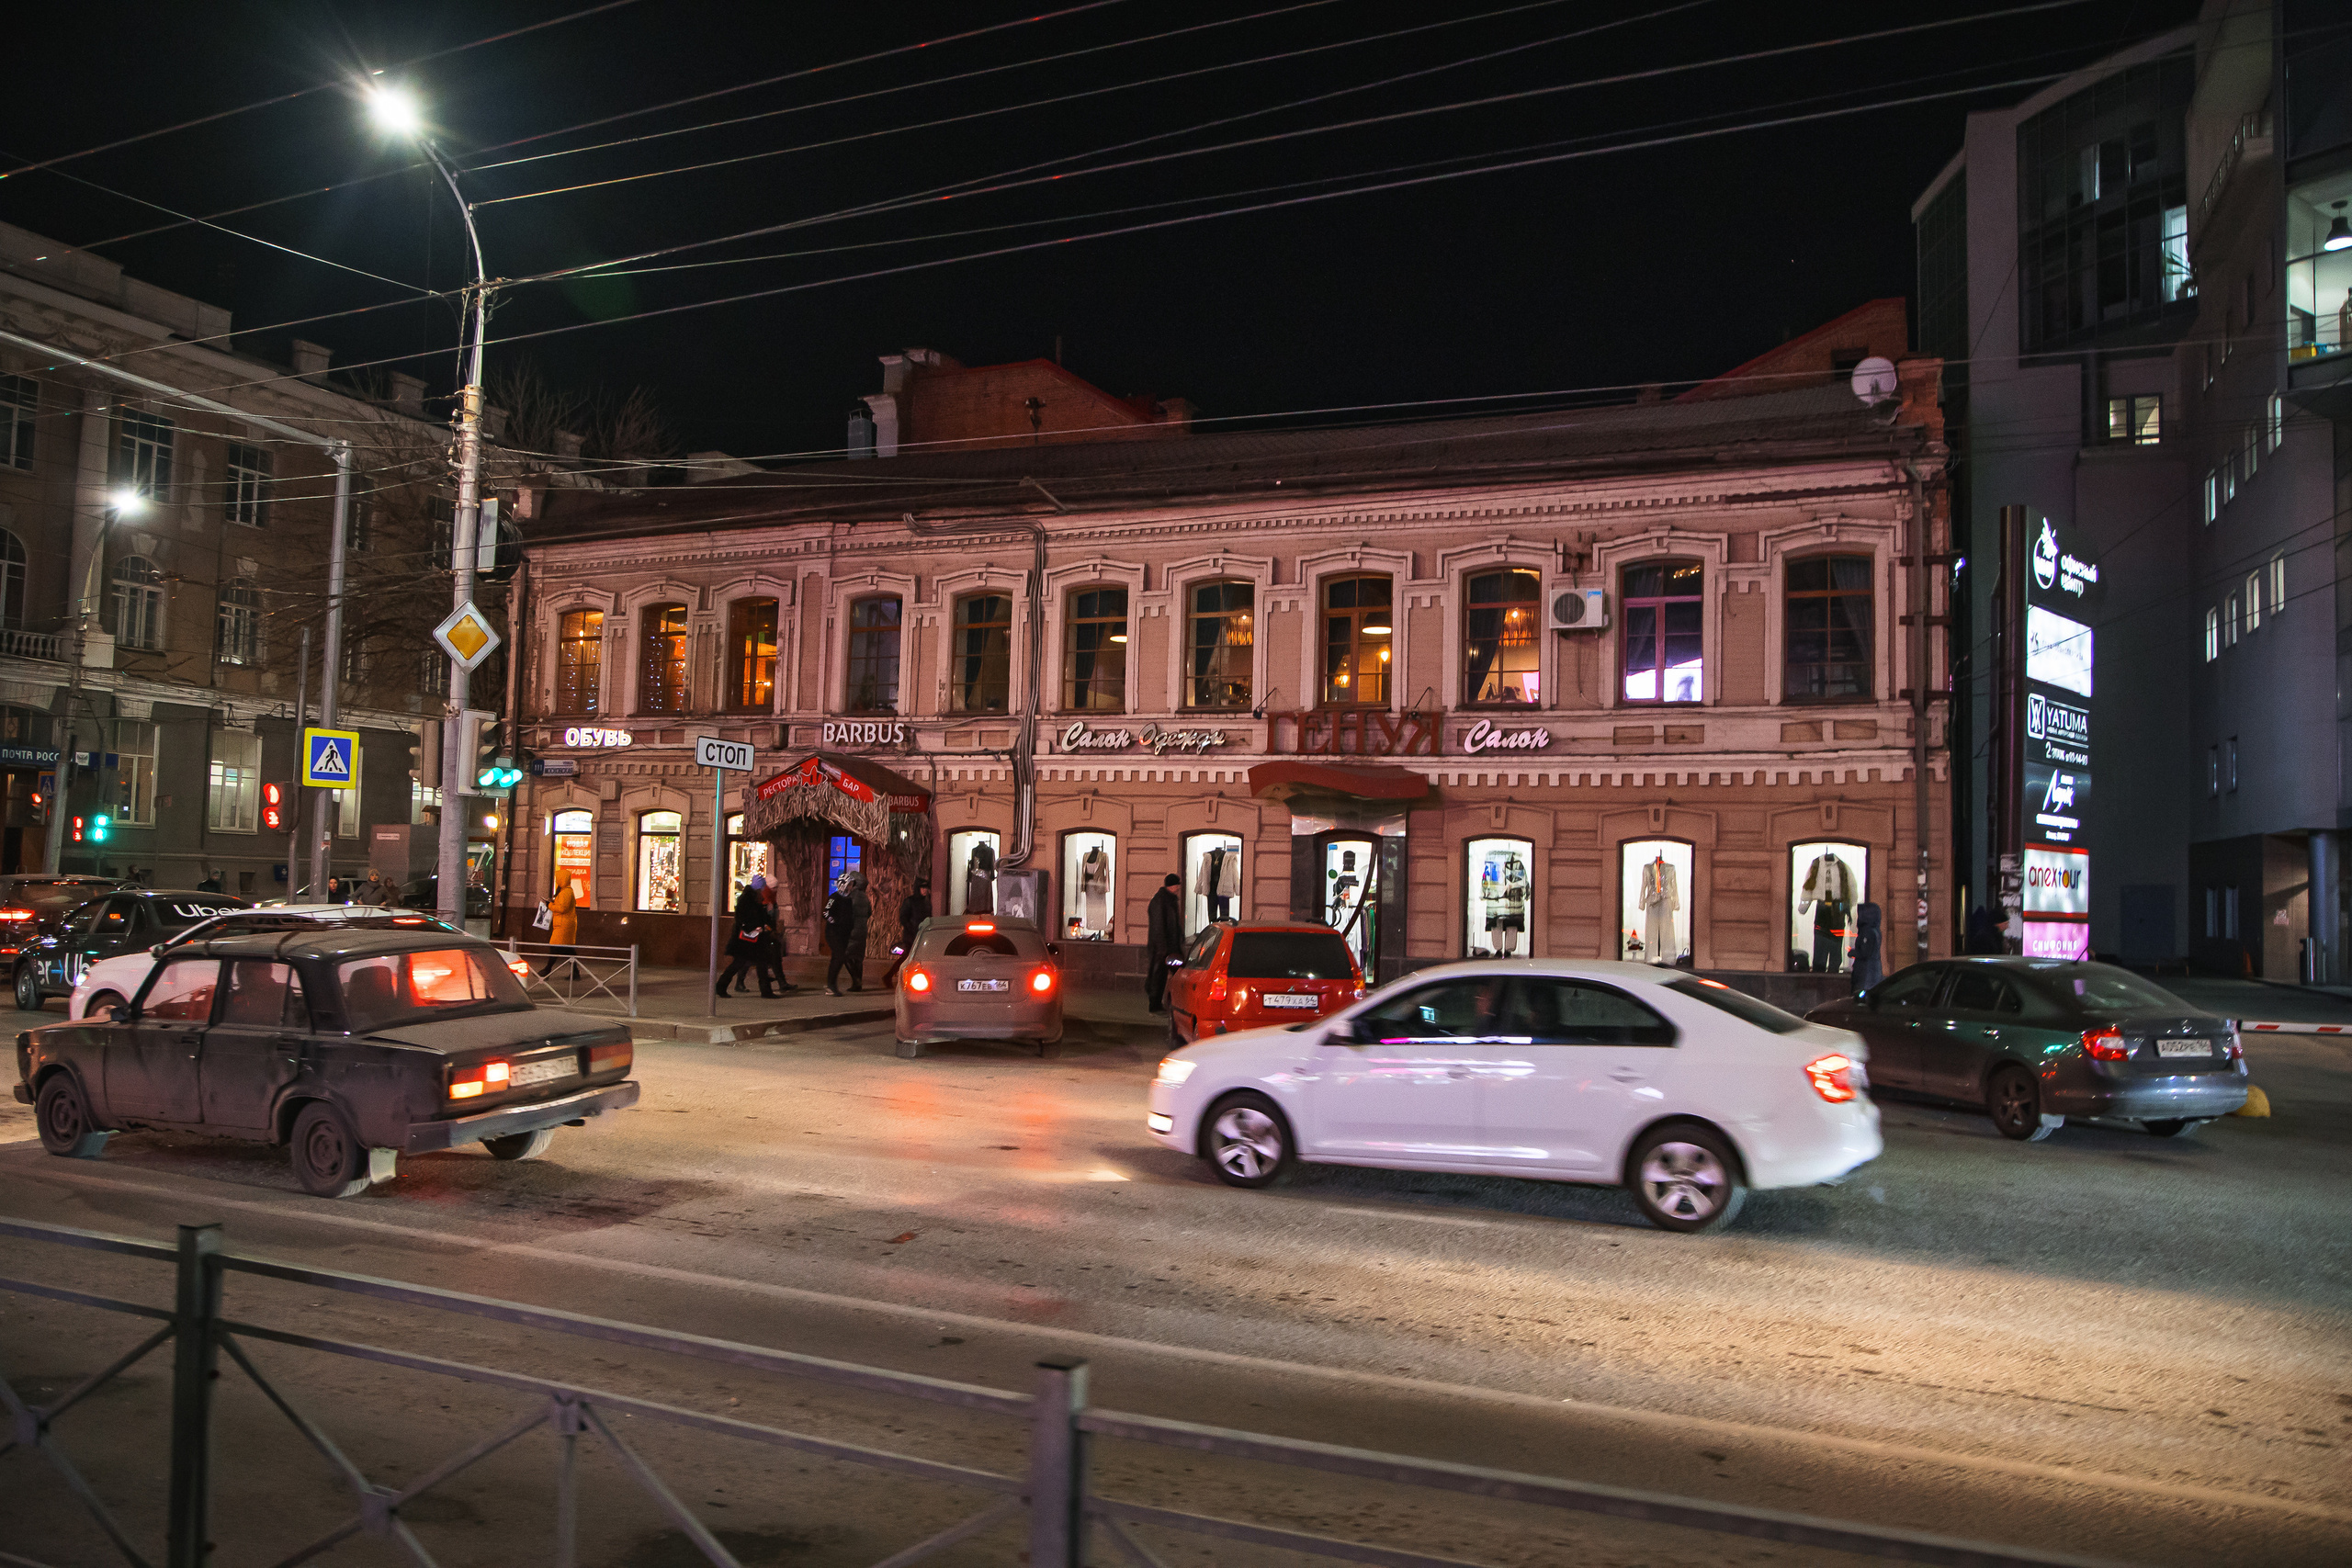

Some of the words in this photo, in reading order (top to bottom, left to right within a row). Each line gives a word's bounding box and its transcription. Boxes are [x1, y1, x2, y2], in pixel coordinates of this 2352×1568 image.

[2046, 706, 2088, 734] YATUMA
[565, 728, 632, 747] ОБУВЬ
[823, 723, 904, 744] BARBUS
[1061, 720, 1130, 751] Салон
[1265, 711, 1444, 755] ГЕНУЯ
[1464, 718, 1550, 753] Салон
[706, 742, 746, 766] СТОП
[842, 778, 859, 792] БАР
[888, 795, 919, 807] BARBUS
[2032, 940, 2077, 953] СИМФОНИЯ
